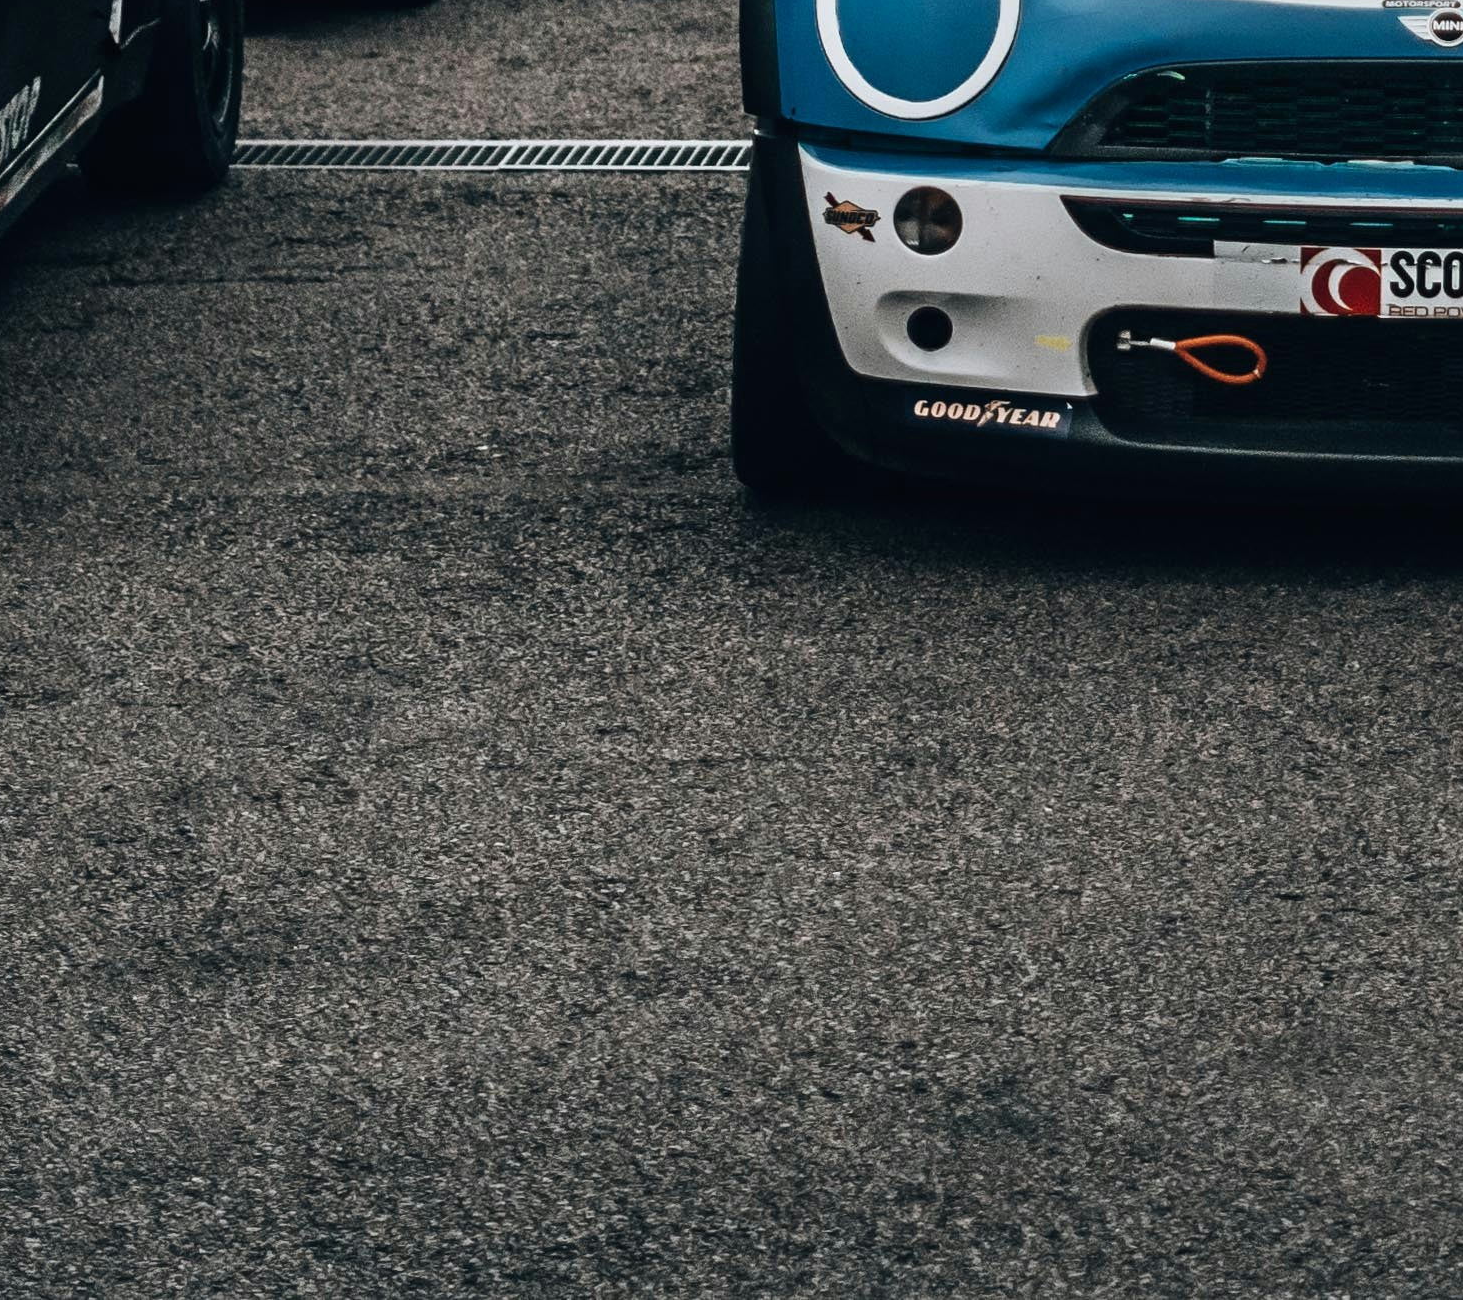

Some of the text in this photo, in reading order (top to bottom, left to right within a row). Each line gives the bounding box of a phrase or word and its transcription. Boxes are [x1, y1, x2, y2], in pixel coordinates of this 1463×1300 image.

[1385, 0, 1460, 8] MOTORSPORT
[822, 209, 880, 228] SUNOCO
[1390, 306, 1429, 318] RED
[913, 399, 1062, 430] GOODYEAR
